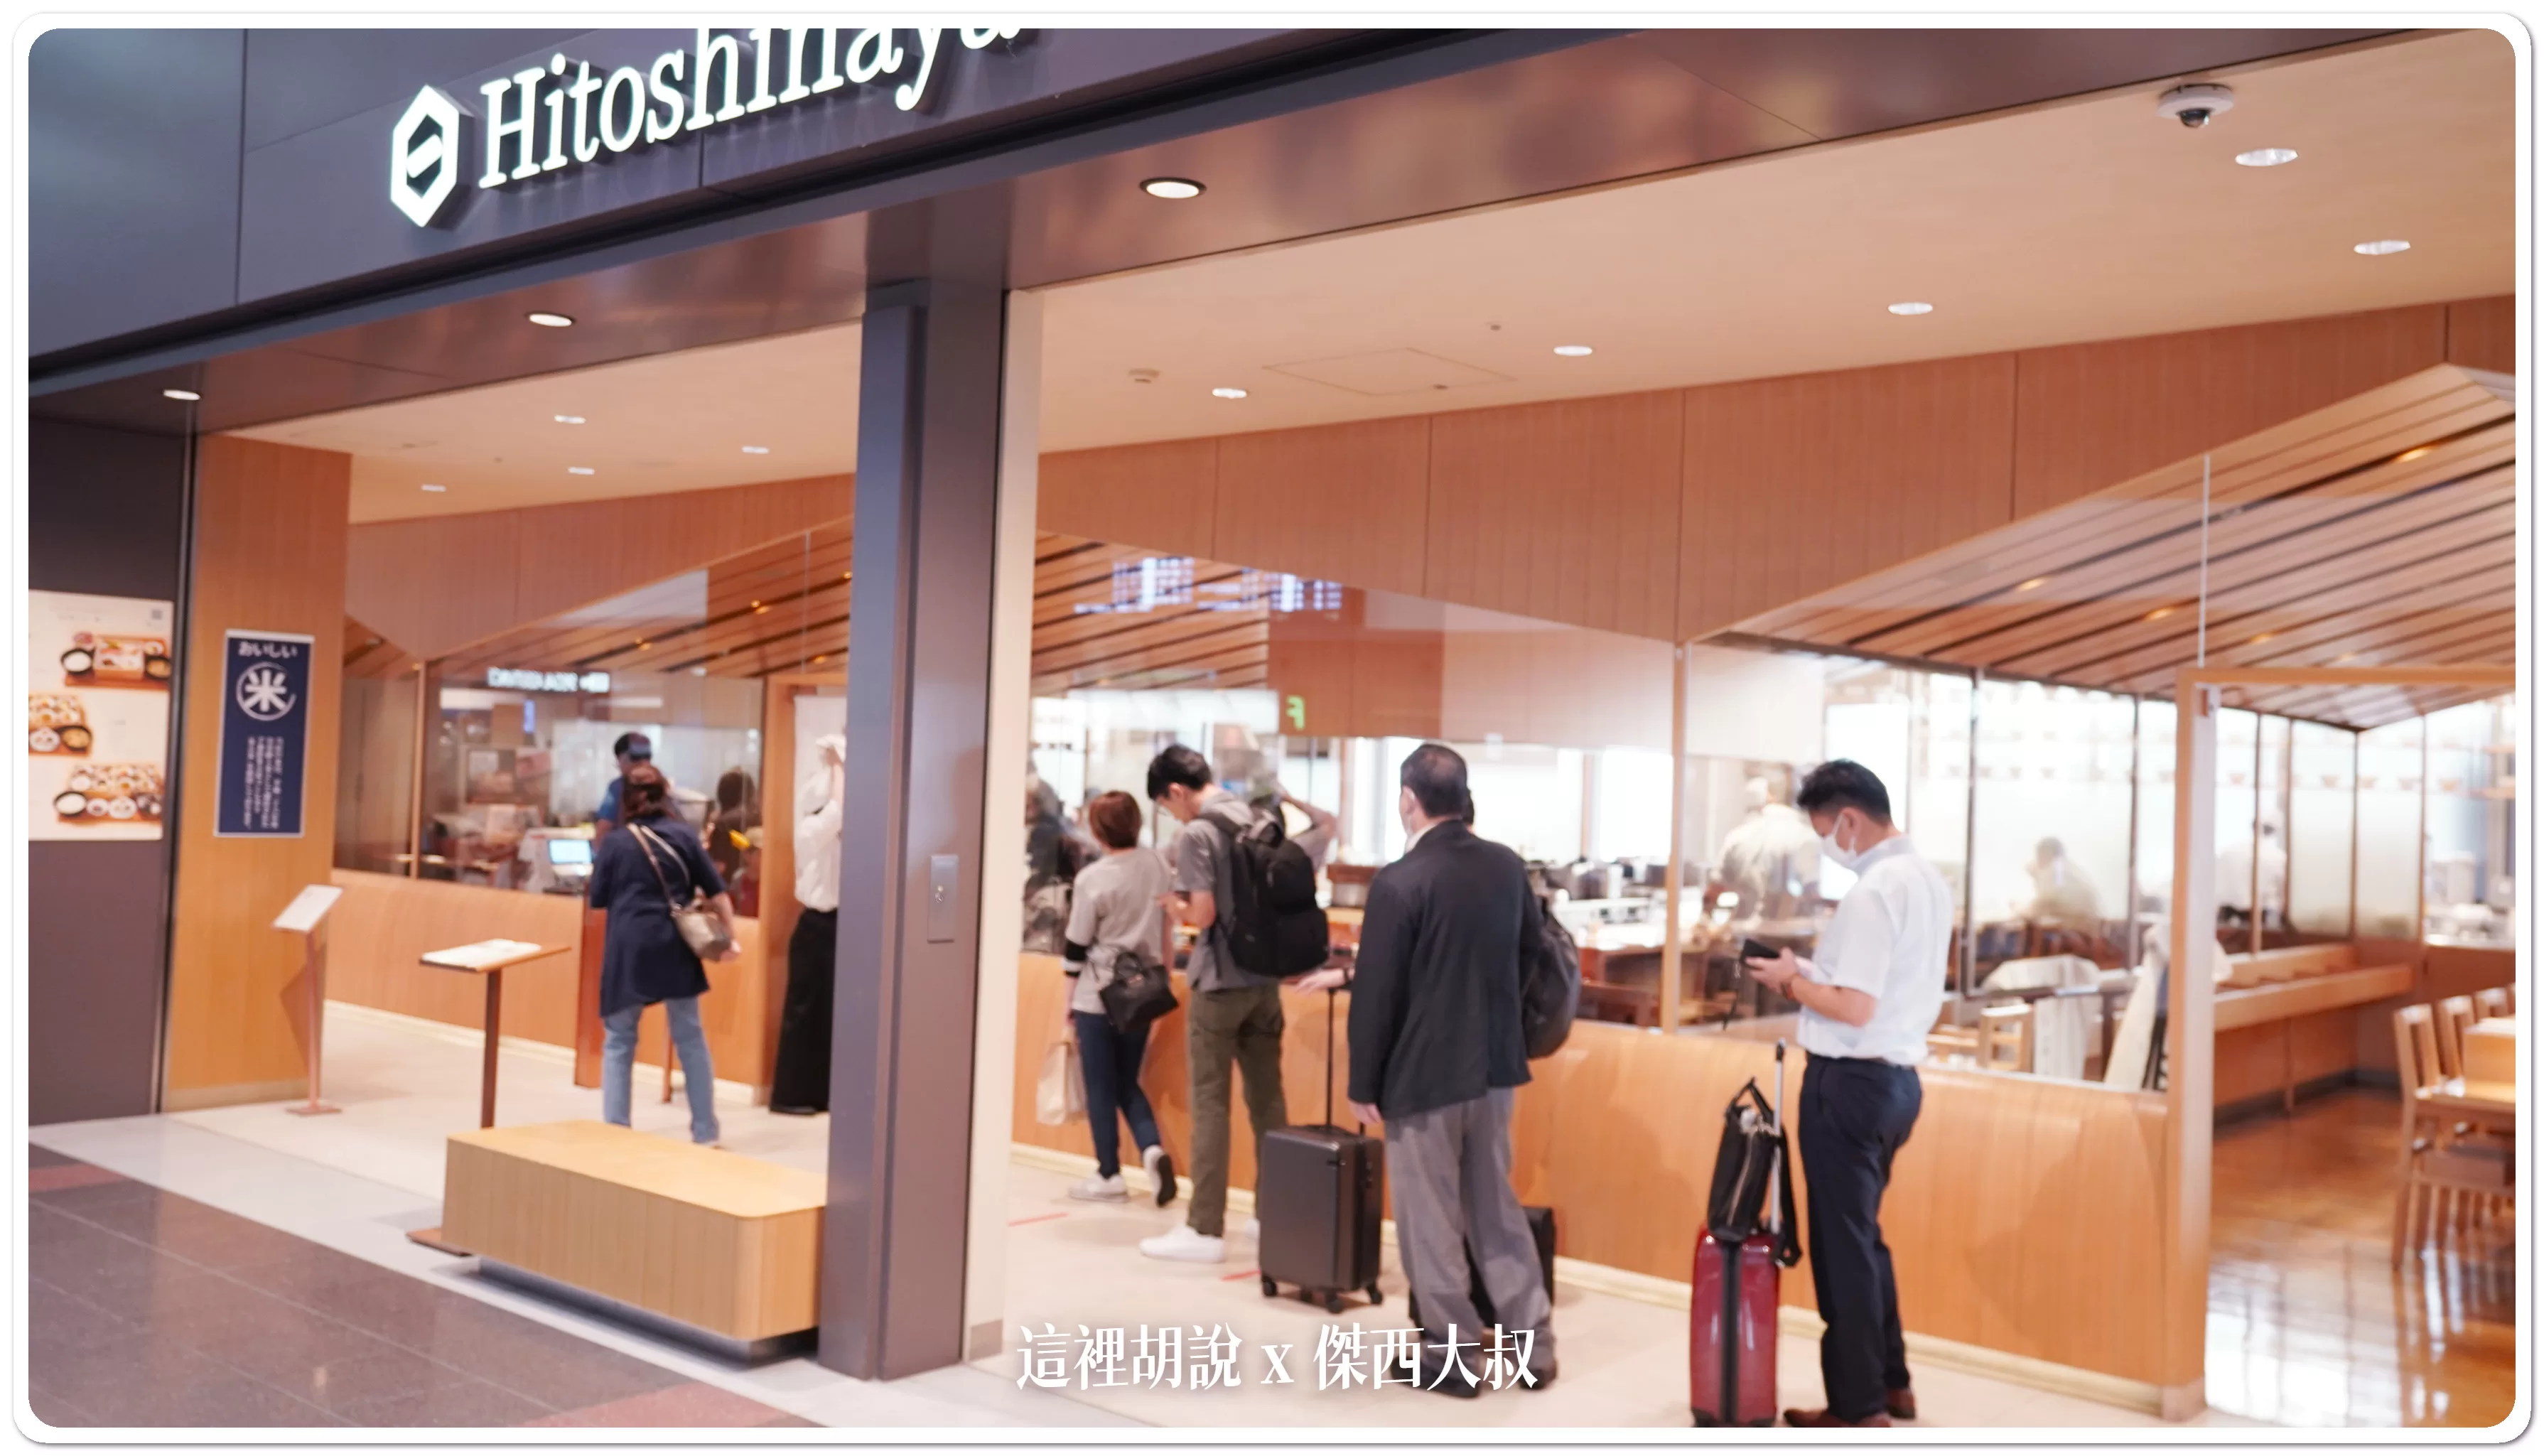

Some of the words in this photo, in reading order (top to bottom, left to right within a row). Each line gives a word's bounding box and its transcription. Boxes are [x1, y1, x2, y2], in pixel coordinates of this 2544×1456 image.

[239, 641, 298, 658] おいしい
[244, 669, 288, 713] 米
